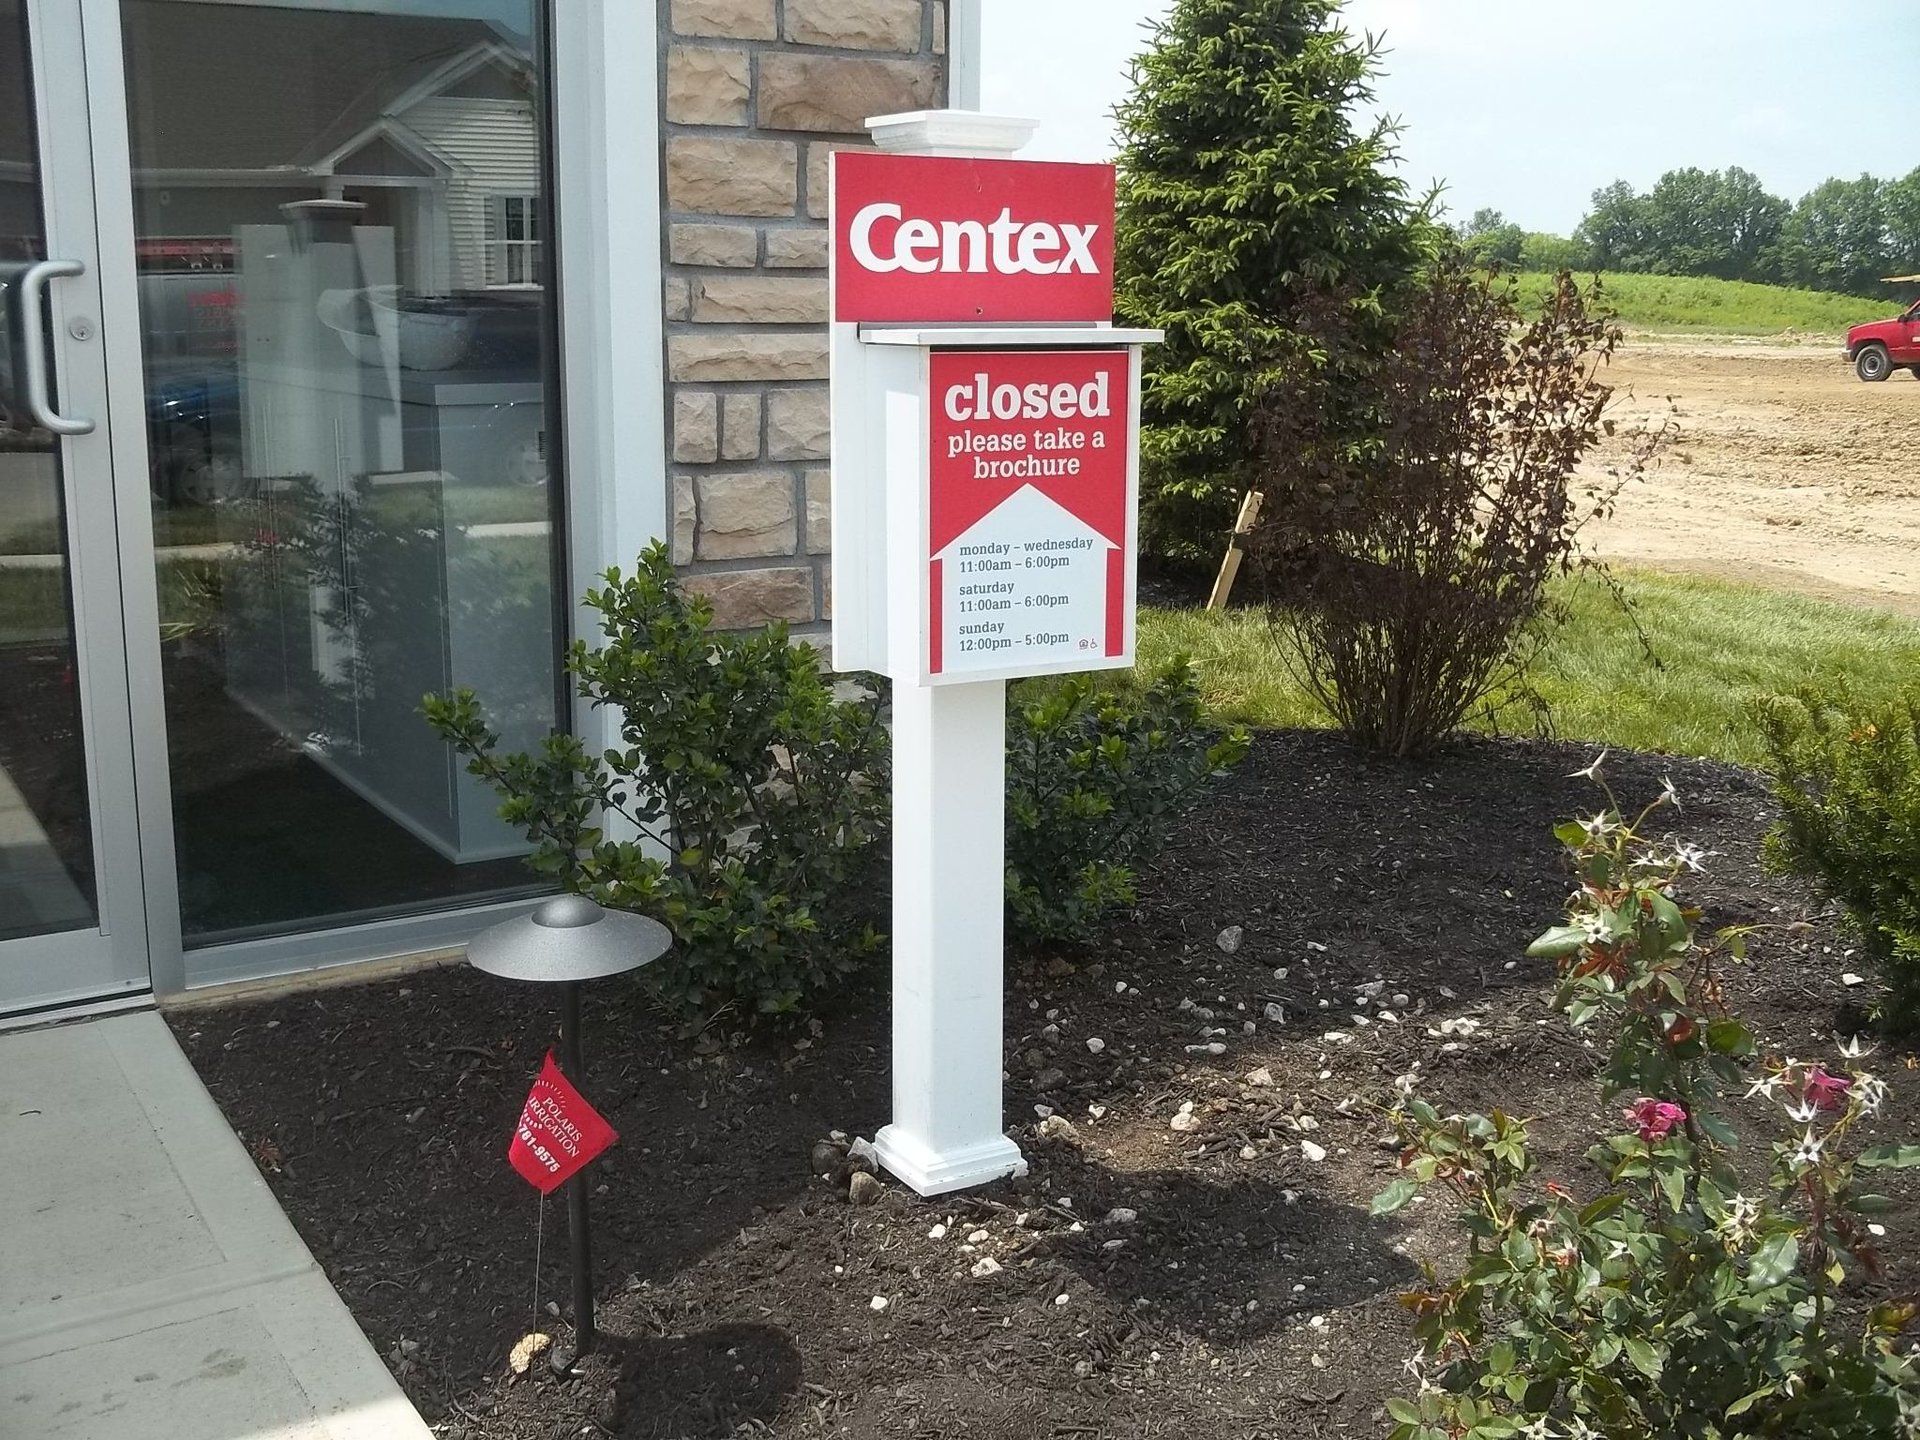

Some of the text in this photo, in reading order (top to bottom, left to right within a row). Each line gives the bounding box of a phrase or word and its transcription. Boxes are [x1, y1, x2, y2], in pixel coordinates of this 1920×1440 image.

[850, 203, 1100, 274] Centex
[945, 372, 1110, 421] closed
[948, 427, 1105, 457] please take a
[973, 455, 1080, 478] brochure
[959, 542, 1010, 556] monday
[1024, 537, 1093, 552] wednesday
[960, 560, 1012, 573] 11:00am
[1025, 556, 1070, 569] 6:00pm
[959, 581, 1015, 595] saturday
[960, 599, 1011, 612] 11:00am
[1025, 594, 1069, 608] 6:00pm
[959, 621, 1005, 635] sunday
[960, 637, 1012, 651] 12:00pm
[1025, 632, 1069, 646] 5:00pm
[529, 1096, 580, 1158] IRRIGATION
[542, 1097, 583, 1142] POLARIS
